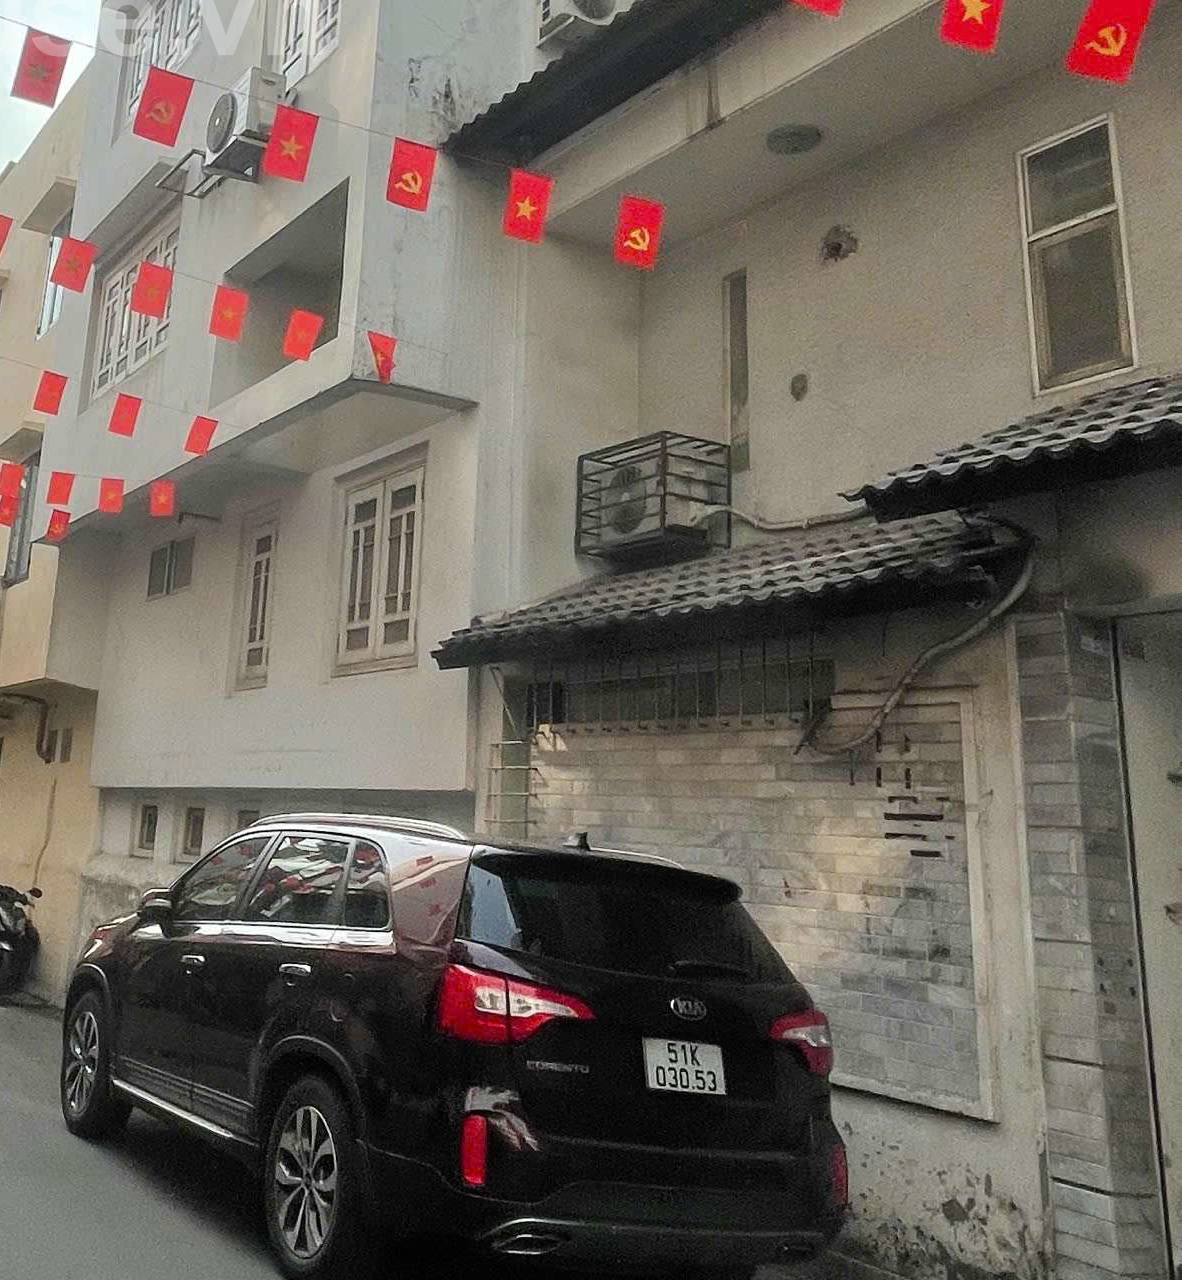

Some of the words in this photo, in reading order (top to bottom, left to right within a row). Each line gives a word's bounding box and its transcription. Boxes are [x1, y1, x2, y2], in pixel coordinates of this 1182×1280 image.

[675, 998, 706, 1018] KIA
[667, 1042, 700, 1066] 51K
[656, 1066, 717, 1091] 030.53
